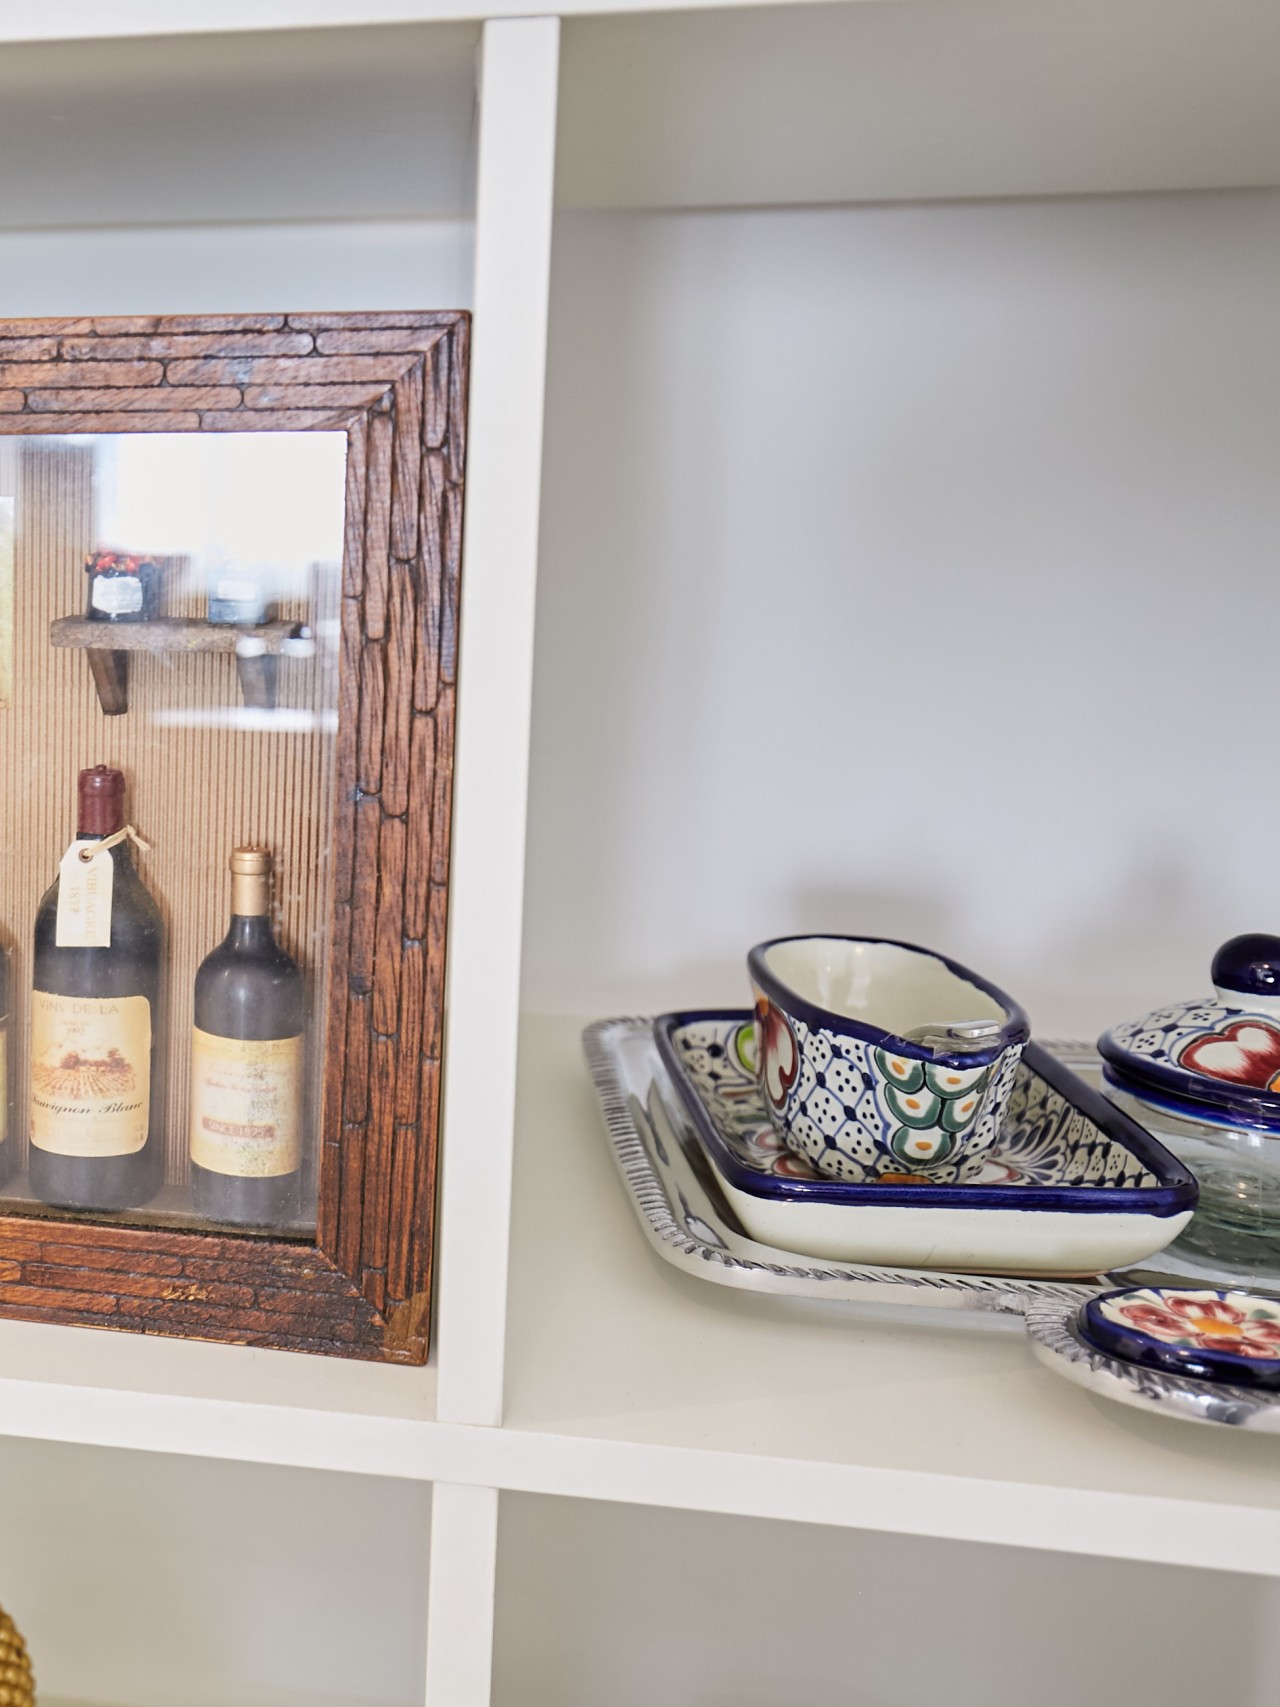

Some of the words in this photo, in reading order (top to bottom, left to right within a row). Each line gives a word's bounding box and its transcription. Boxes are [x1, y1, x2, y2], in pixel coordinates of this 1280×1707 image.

[40, 999, 64, 1013] VINS
[72, 1003, 91, 1015] DE
[100, 1004, 120, 1016] LA
[98, 1100, 144, 1114] Blanc
